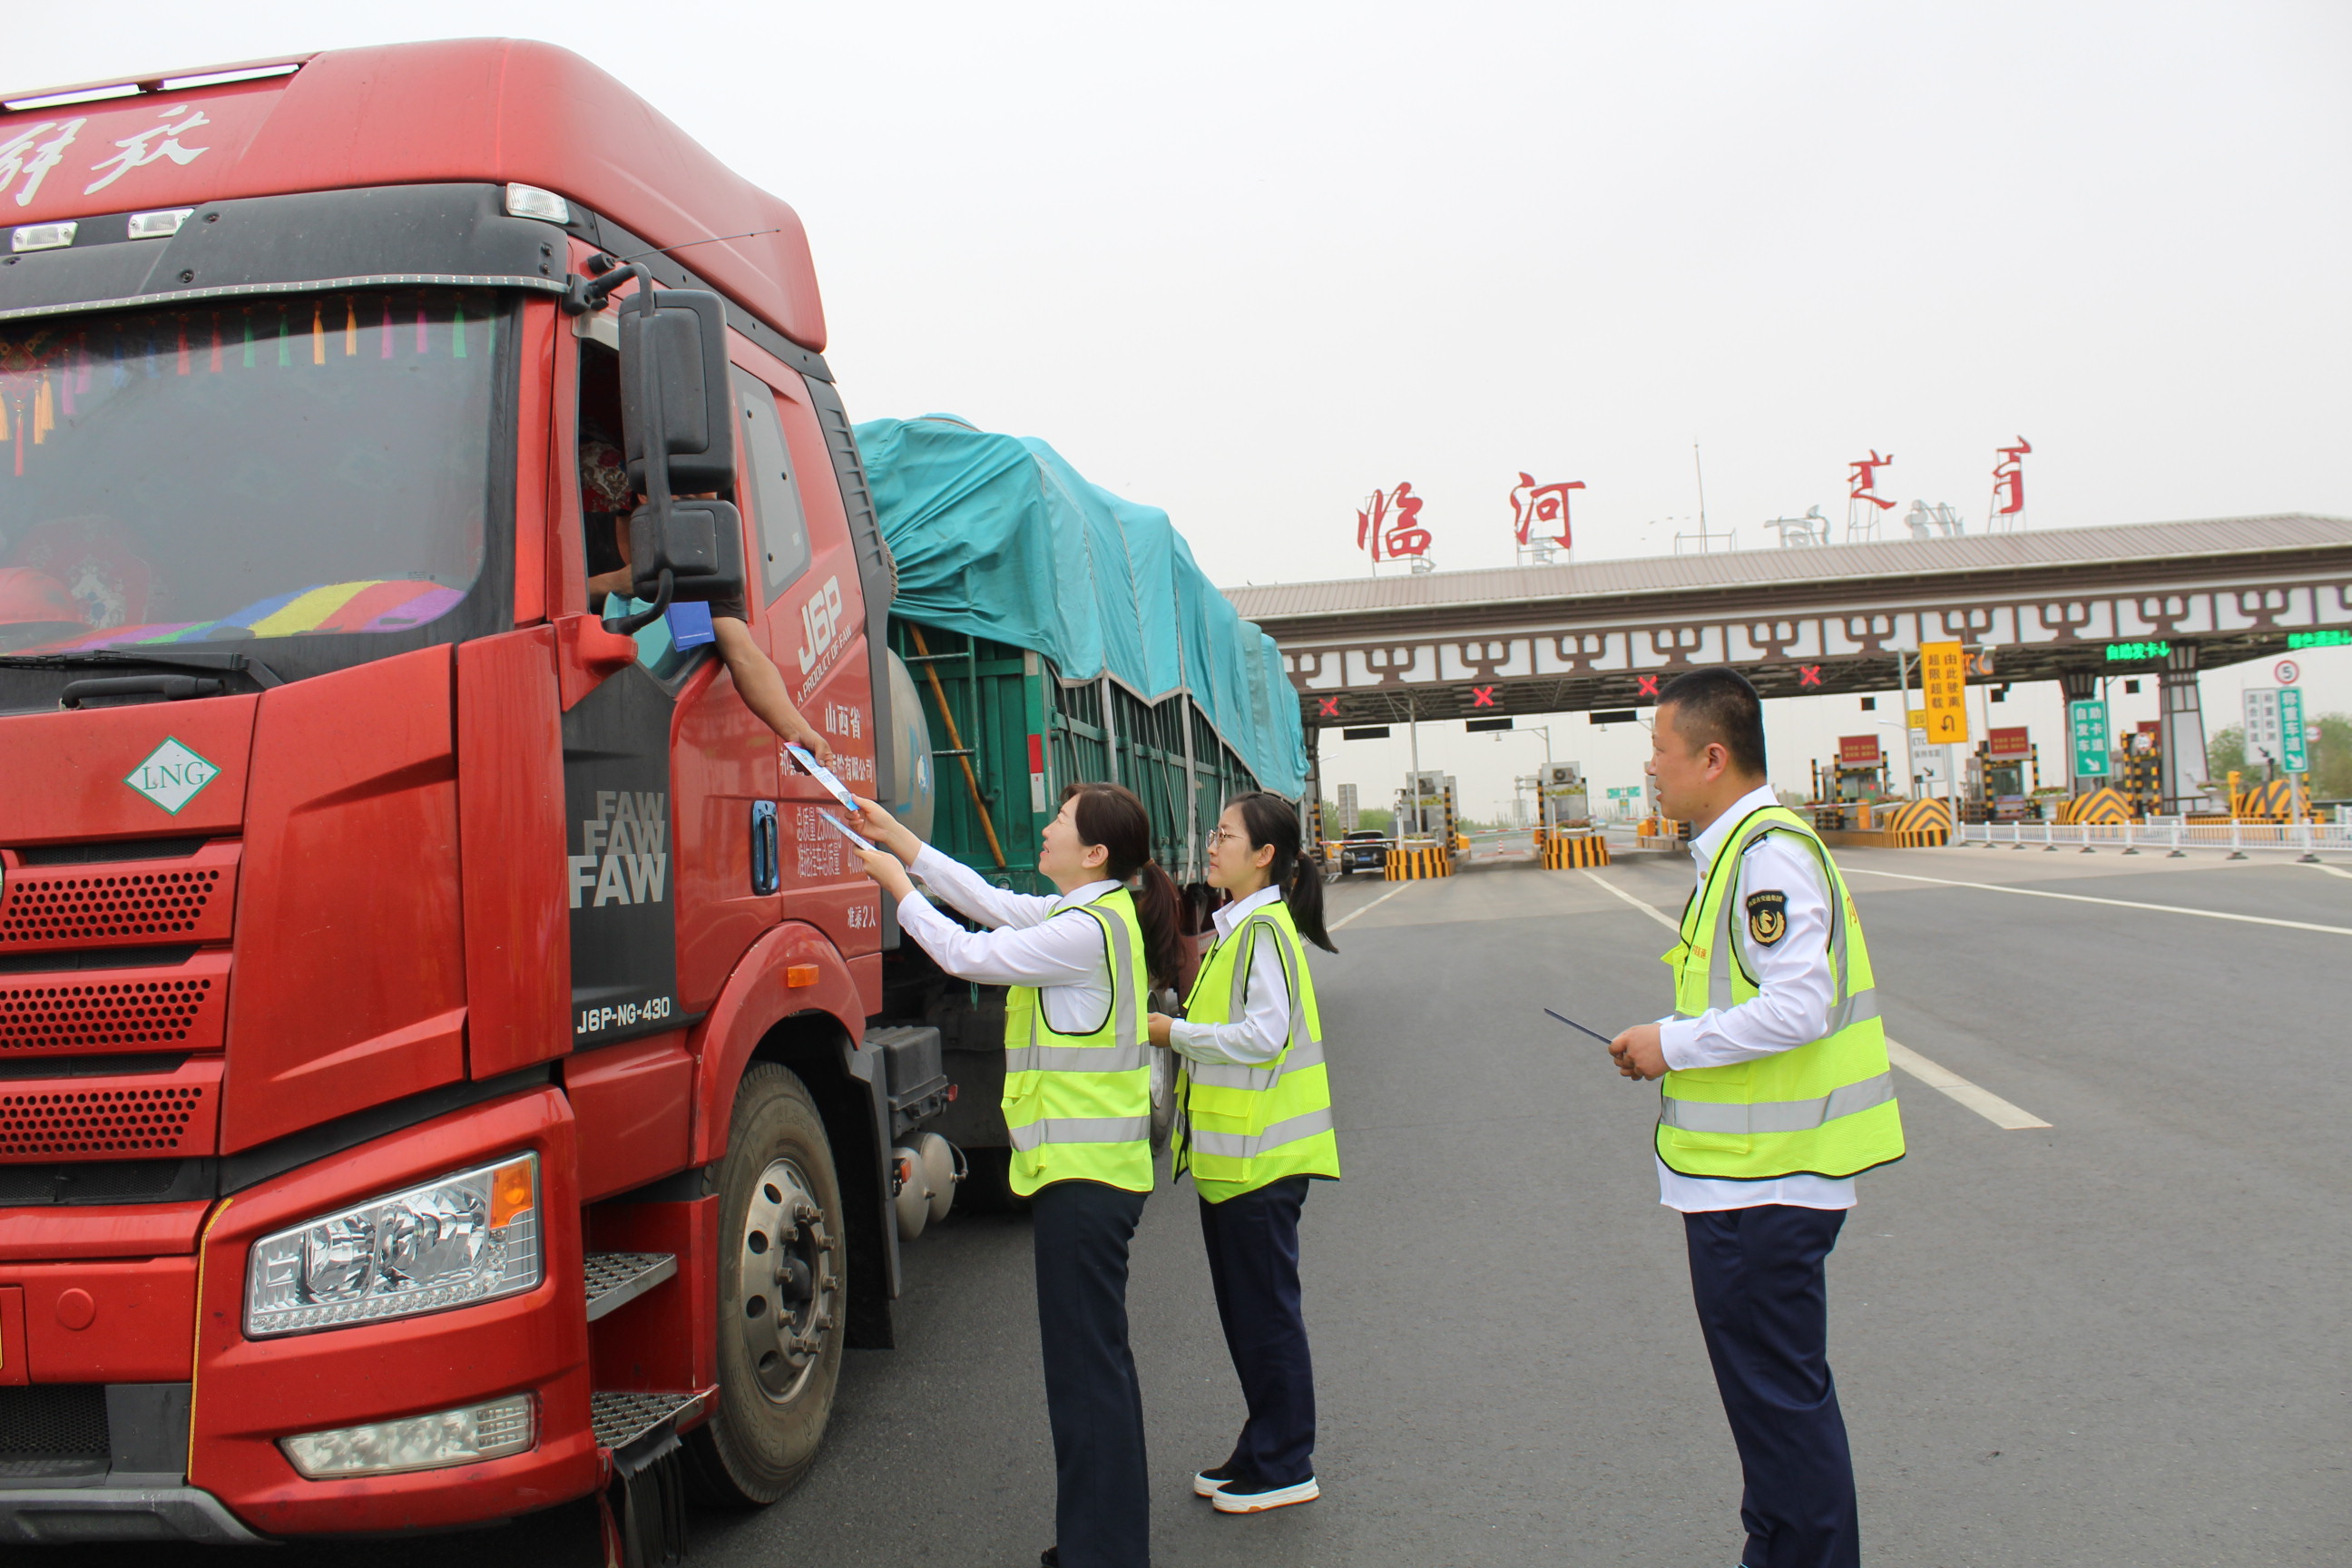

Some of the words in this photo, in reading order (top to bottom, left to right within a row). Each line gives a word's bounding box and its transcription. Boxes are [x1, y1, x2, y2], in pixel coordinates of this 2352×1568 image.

[1356, 472, 1586, 563] 临河
[798, 575, 842, 675] J6P
[797, 691, 803, 707] A
[803, 652, 831, 698] PRODUCT
[830, 641, 839, 660] OF
[838, 623, 852, 648] FAW
[2106, 642, 2158, 661] 自助发卡
[1927, 654, 1944, 709] 超限超载
[2283, 666, 2292, 680] 5
[825, 701, 861, 740] 山西省
[2076, 707, 2102, 720] 自助
[2077, 722, 2103, 736] 发卡
[2281, 691, 2302, 751] 称重车道
[2077, 739, 2105, 752] 车道
[142, 761, 205, 789] LNG
[596, 790, 664, 829] FAW
[583, 819, 665, 862] FAW
[567, 853, 666, 908] FAW
[848, 906, 876, 929] 准乘2人
[577, 996, 671, 1034] J6P-NG-430
